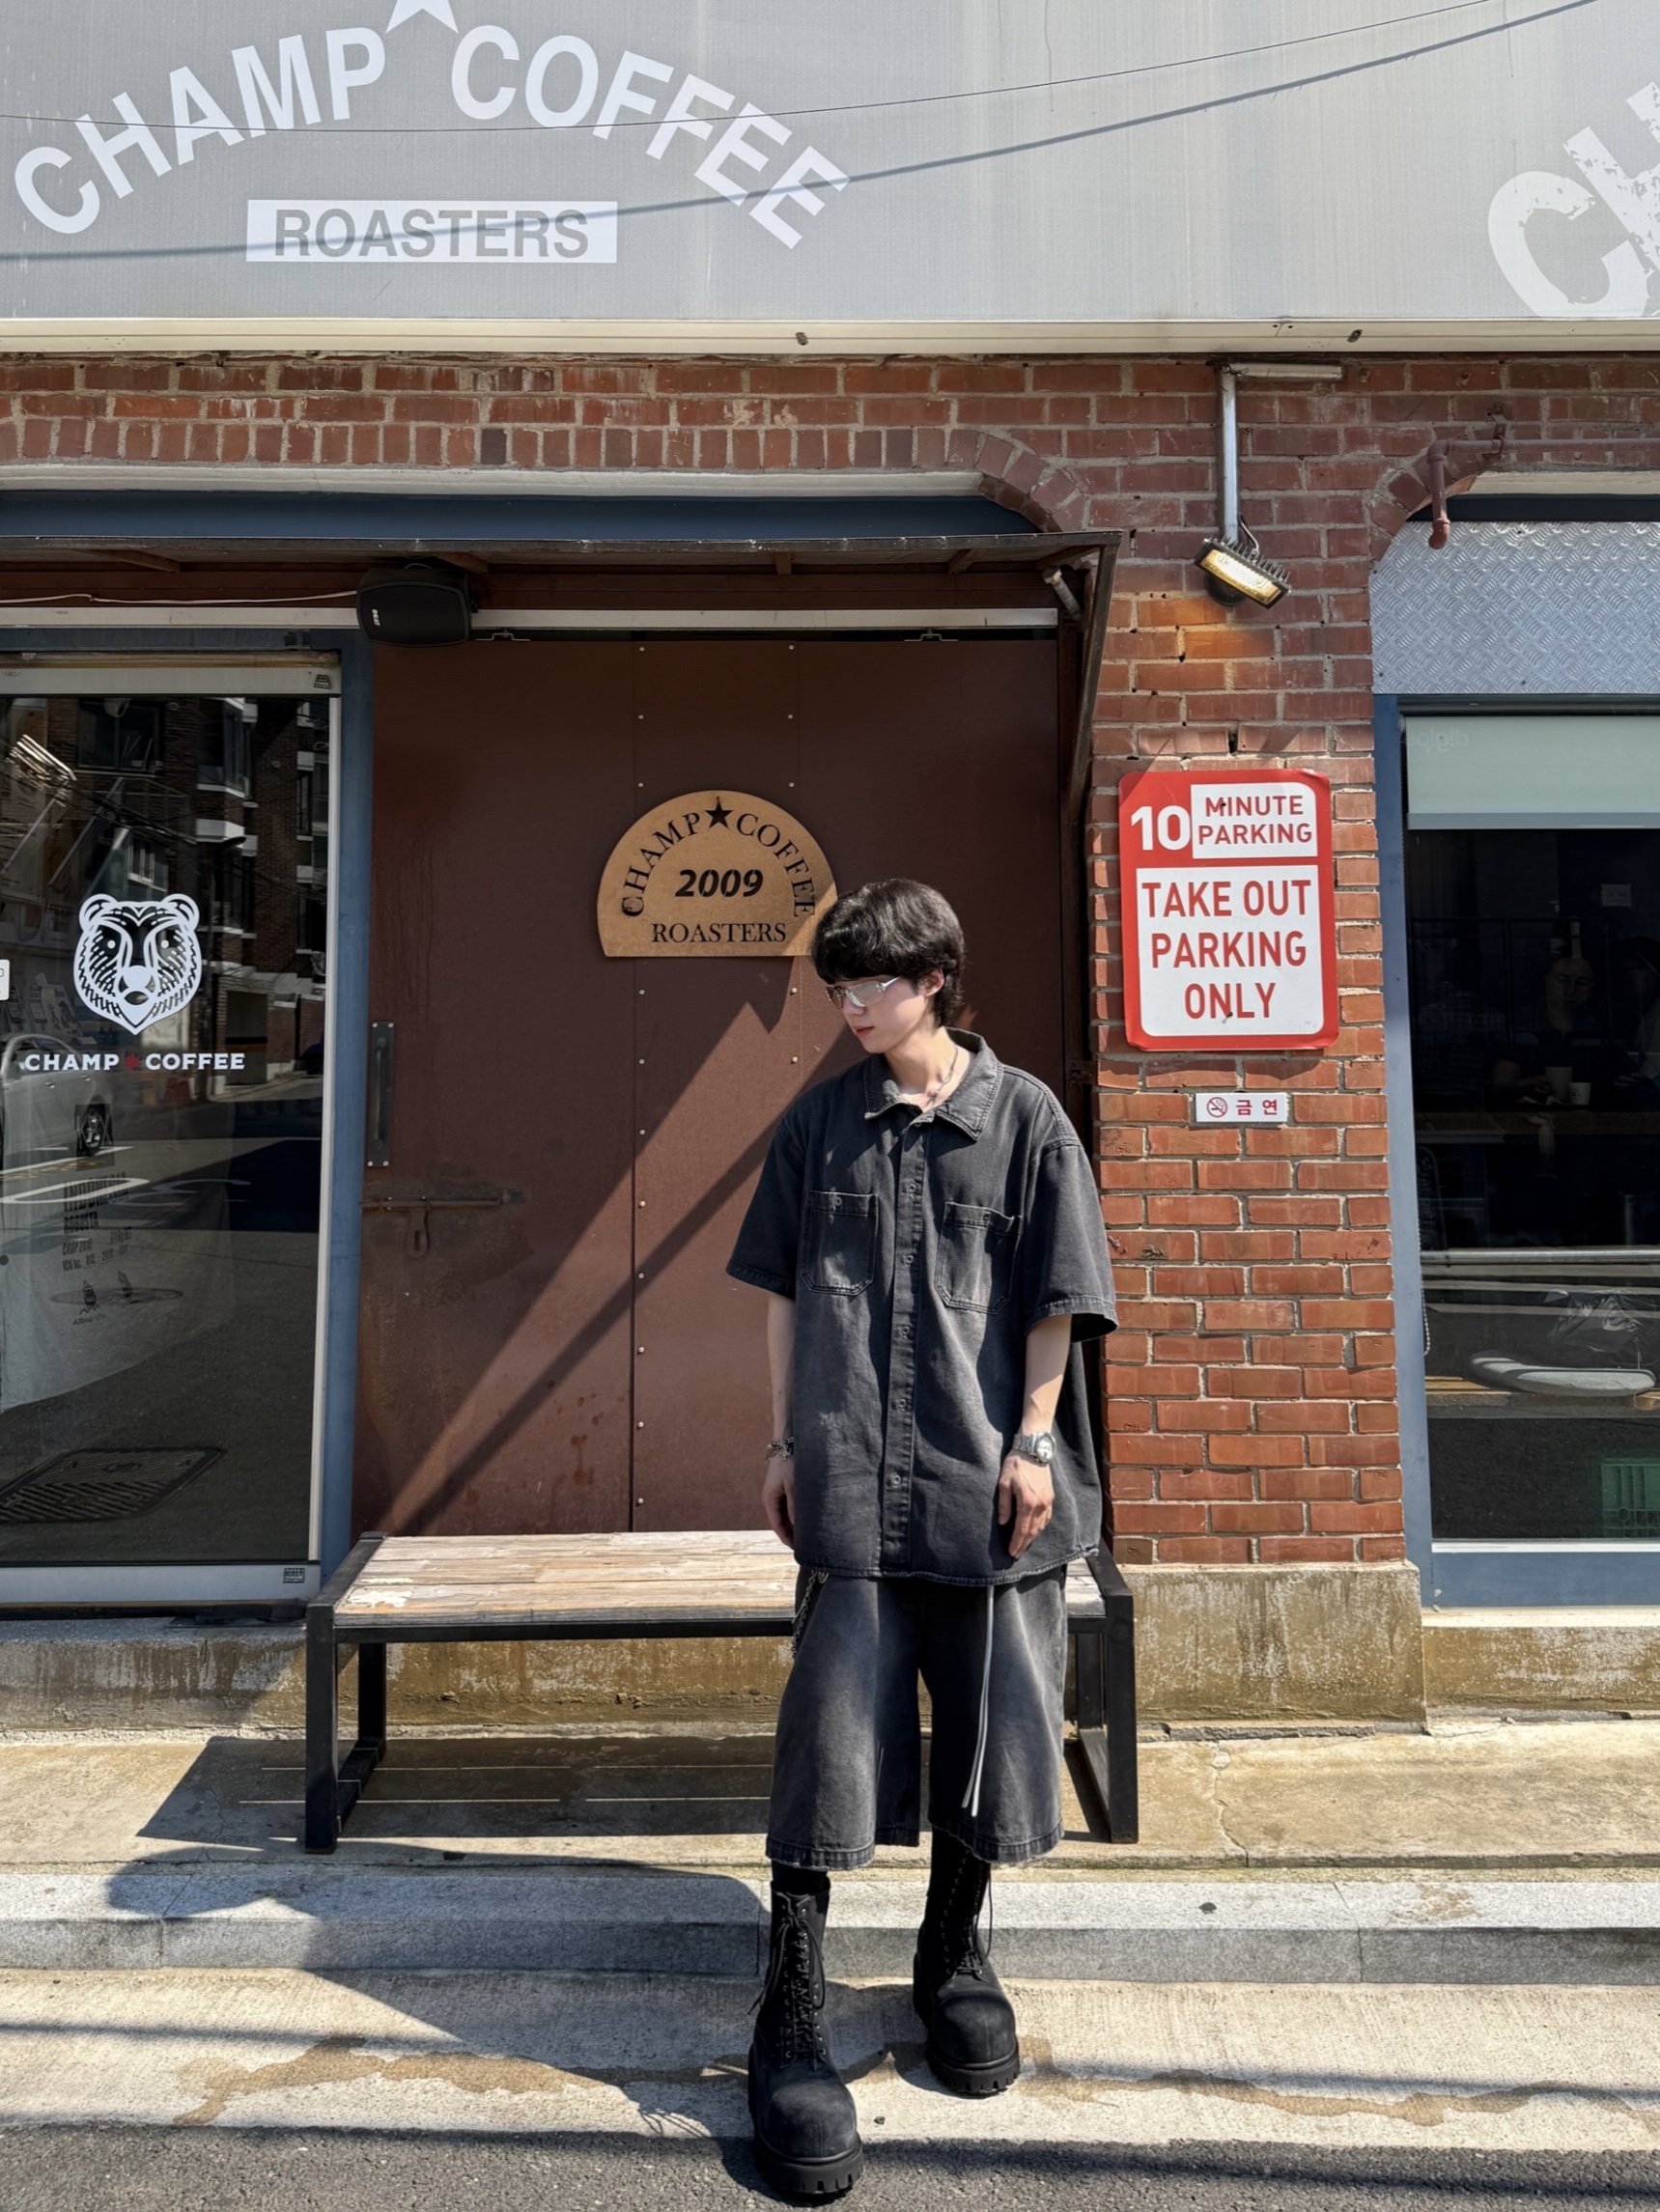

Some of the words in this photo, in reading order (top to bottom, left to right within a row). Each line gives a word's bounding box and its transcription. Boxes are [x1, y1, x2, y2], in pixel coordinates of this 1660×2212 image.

[14, 27, 386, 235] CHAMP
[452, 25, 851, 249] COFFEE
[274, 209, 589, 259] ROASTERS
[1205, 795, 1304, 817] MINUTE
[1131, 804, 1191, 851] 10
[1198, 823, 1312, 845] PARKING
[621, 812, 701, 917] CHAMP
[736, 813, 816, 917] COFFEE
[674, 869, 764, 897] 2009
[1141, 882, 1232, 917] TAKE
[1243, 880, 1311, 916] OUT
[652, 922, 787, 943] ROASTERS
[1151, 931, 1307, 968] PARKING
[1185, 982, 1277, 1020] ONLY
[25, 1053, 120, 1071] CHAMP
[145, 1052, 245, 1071] COFFEE
